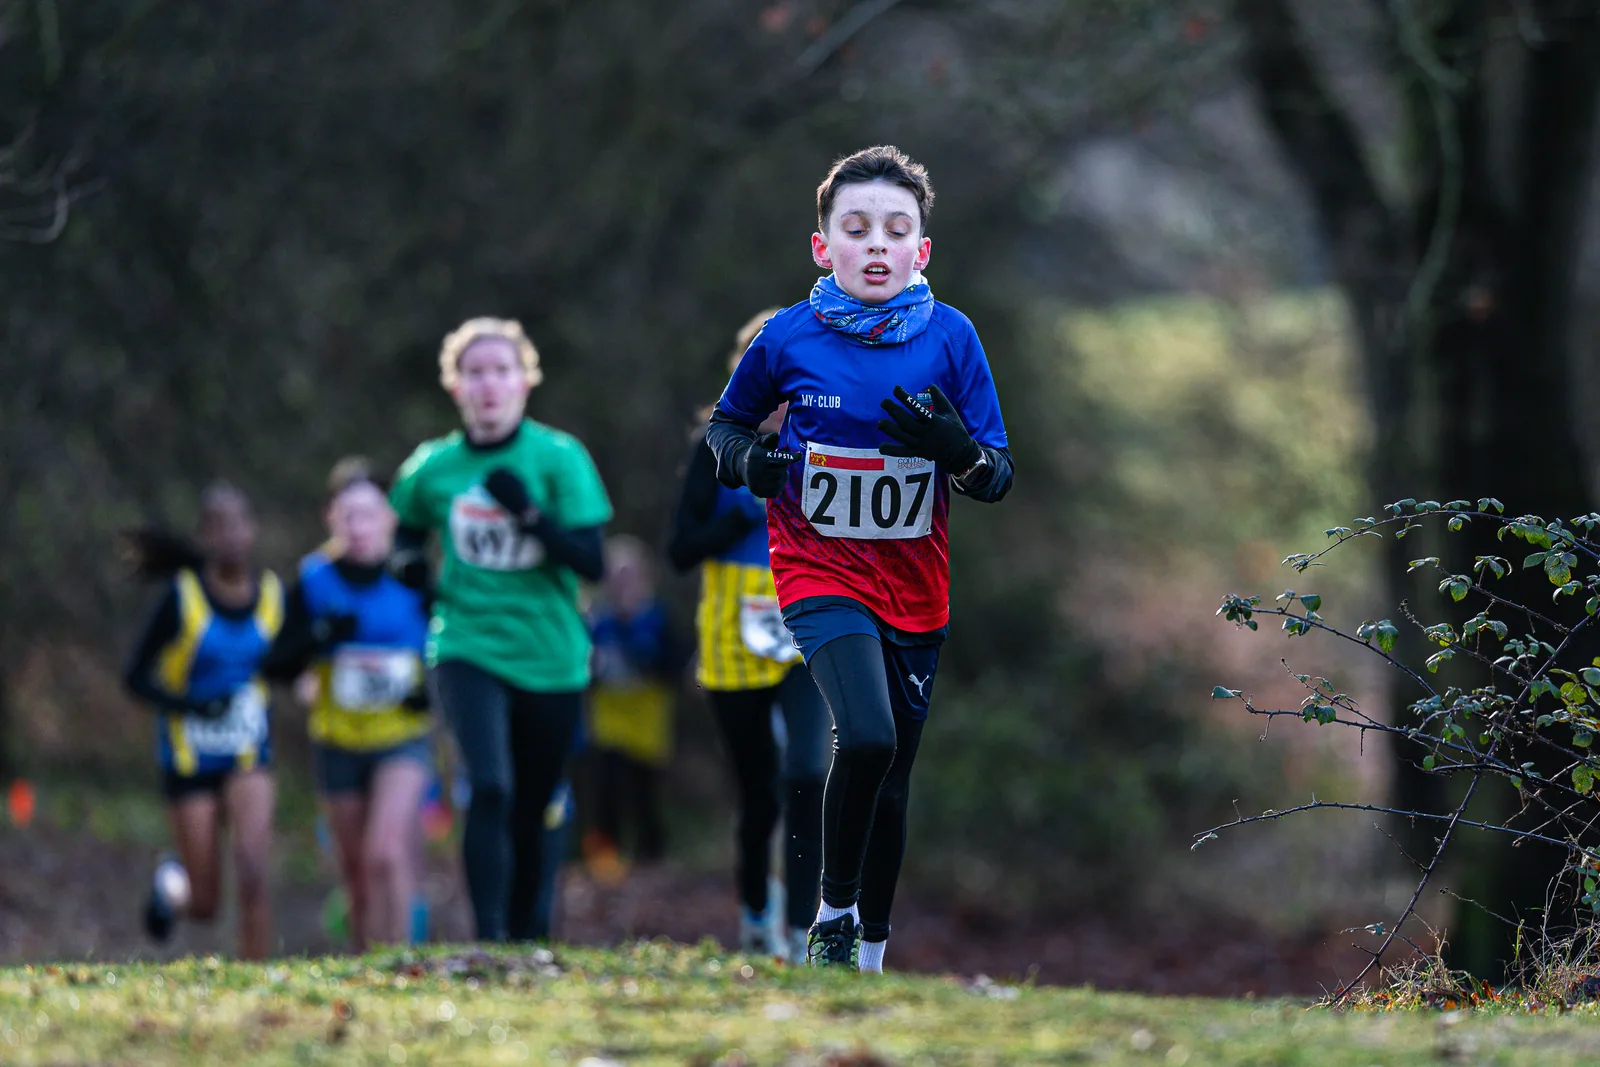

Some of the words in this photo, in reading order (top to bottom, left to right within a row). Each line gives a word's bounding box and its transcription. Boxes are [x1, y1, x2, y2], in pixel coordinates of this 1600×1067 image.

[906, 396, 933, 419] KIPSTA
[766, 451, 794, 460] KIPSTA
[809, 471, 933, 529] 2107
